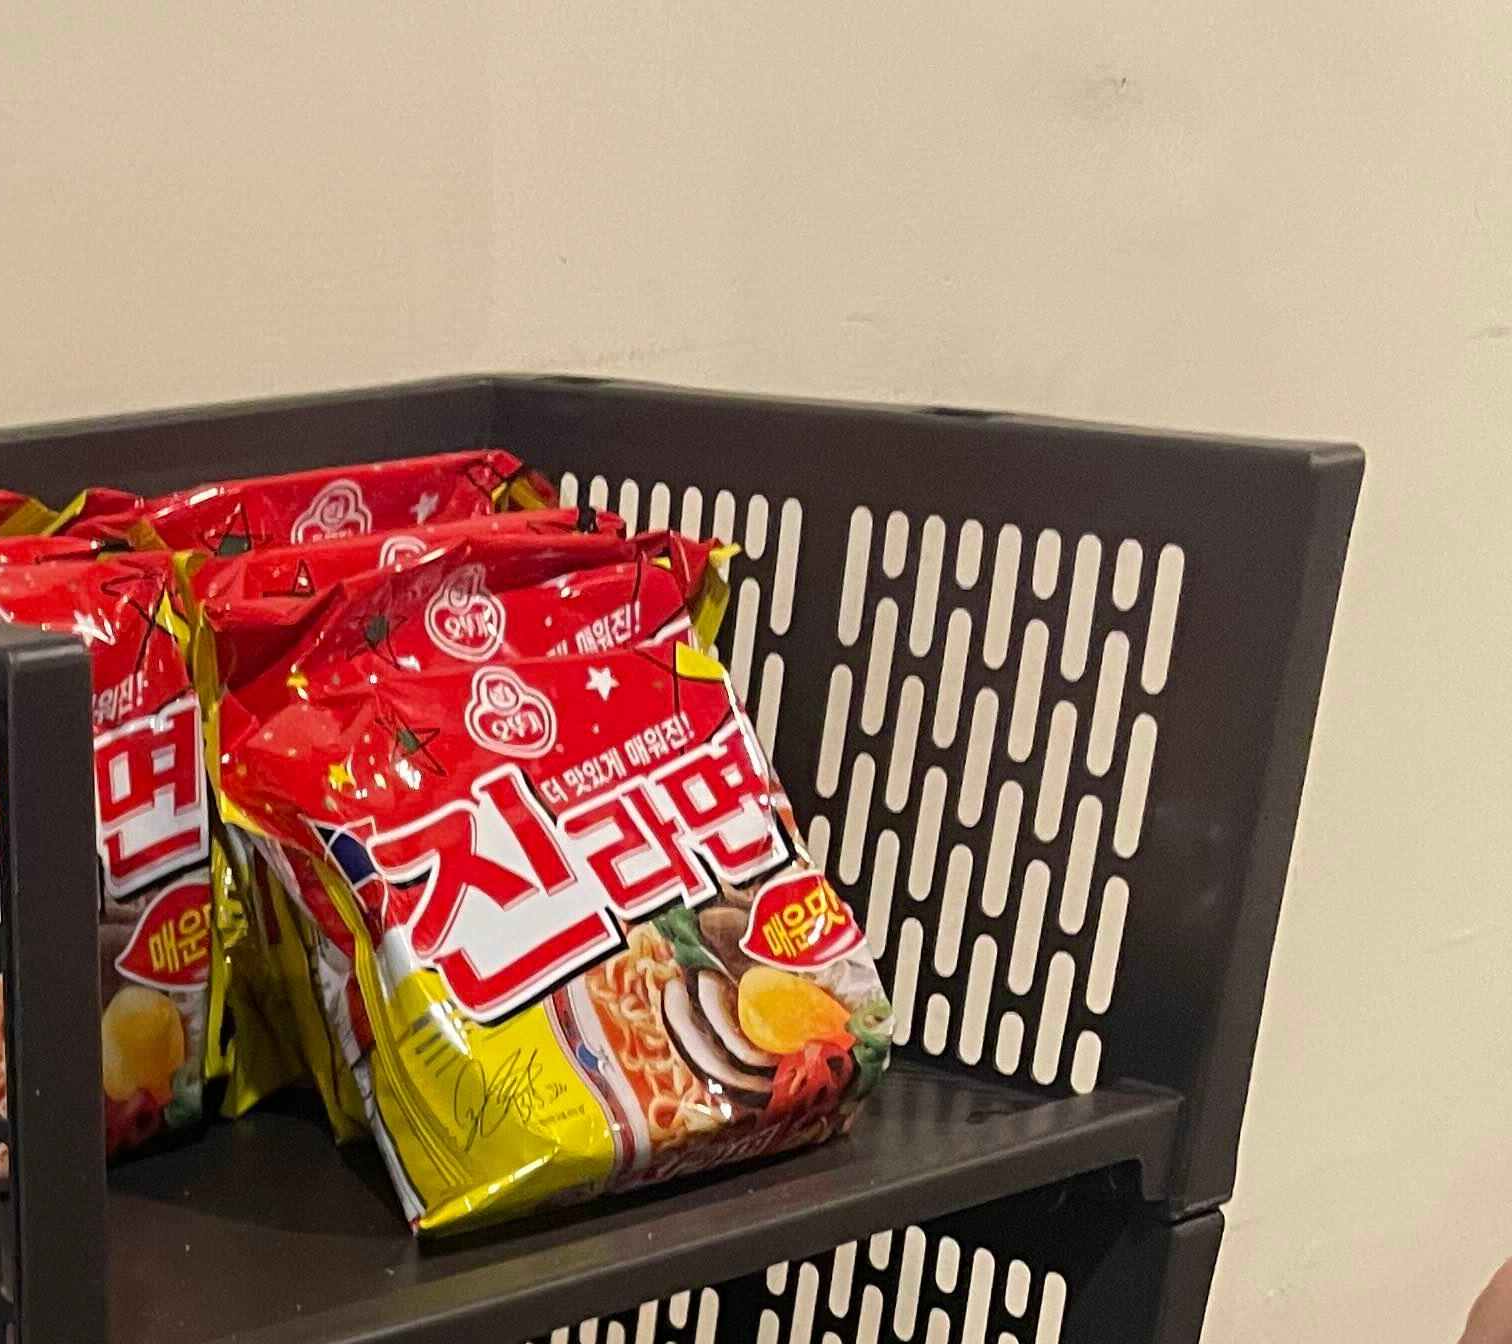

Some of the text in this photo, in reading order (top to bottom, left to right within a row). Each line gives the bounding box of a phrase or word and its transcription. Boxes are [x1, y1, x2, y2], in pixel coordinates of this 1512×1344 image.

[540, 711, 696, 804] 더 맛있게 매워진!
[368, 718, 790, 1026] 진라면
[765, 876, 847, 959] 매운맛
